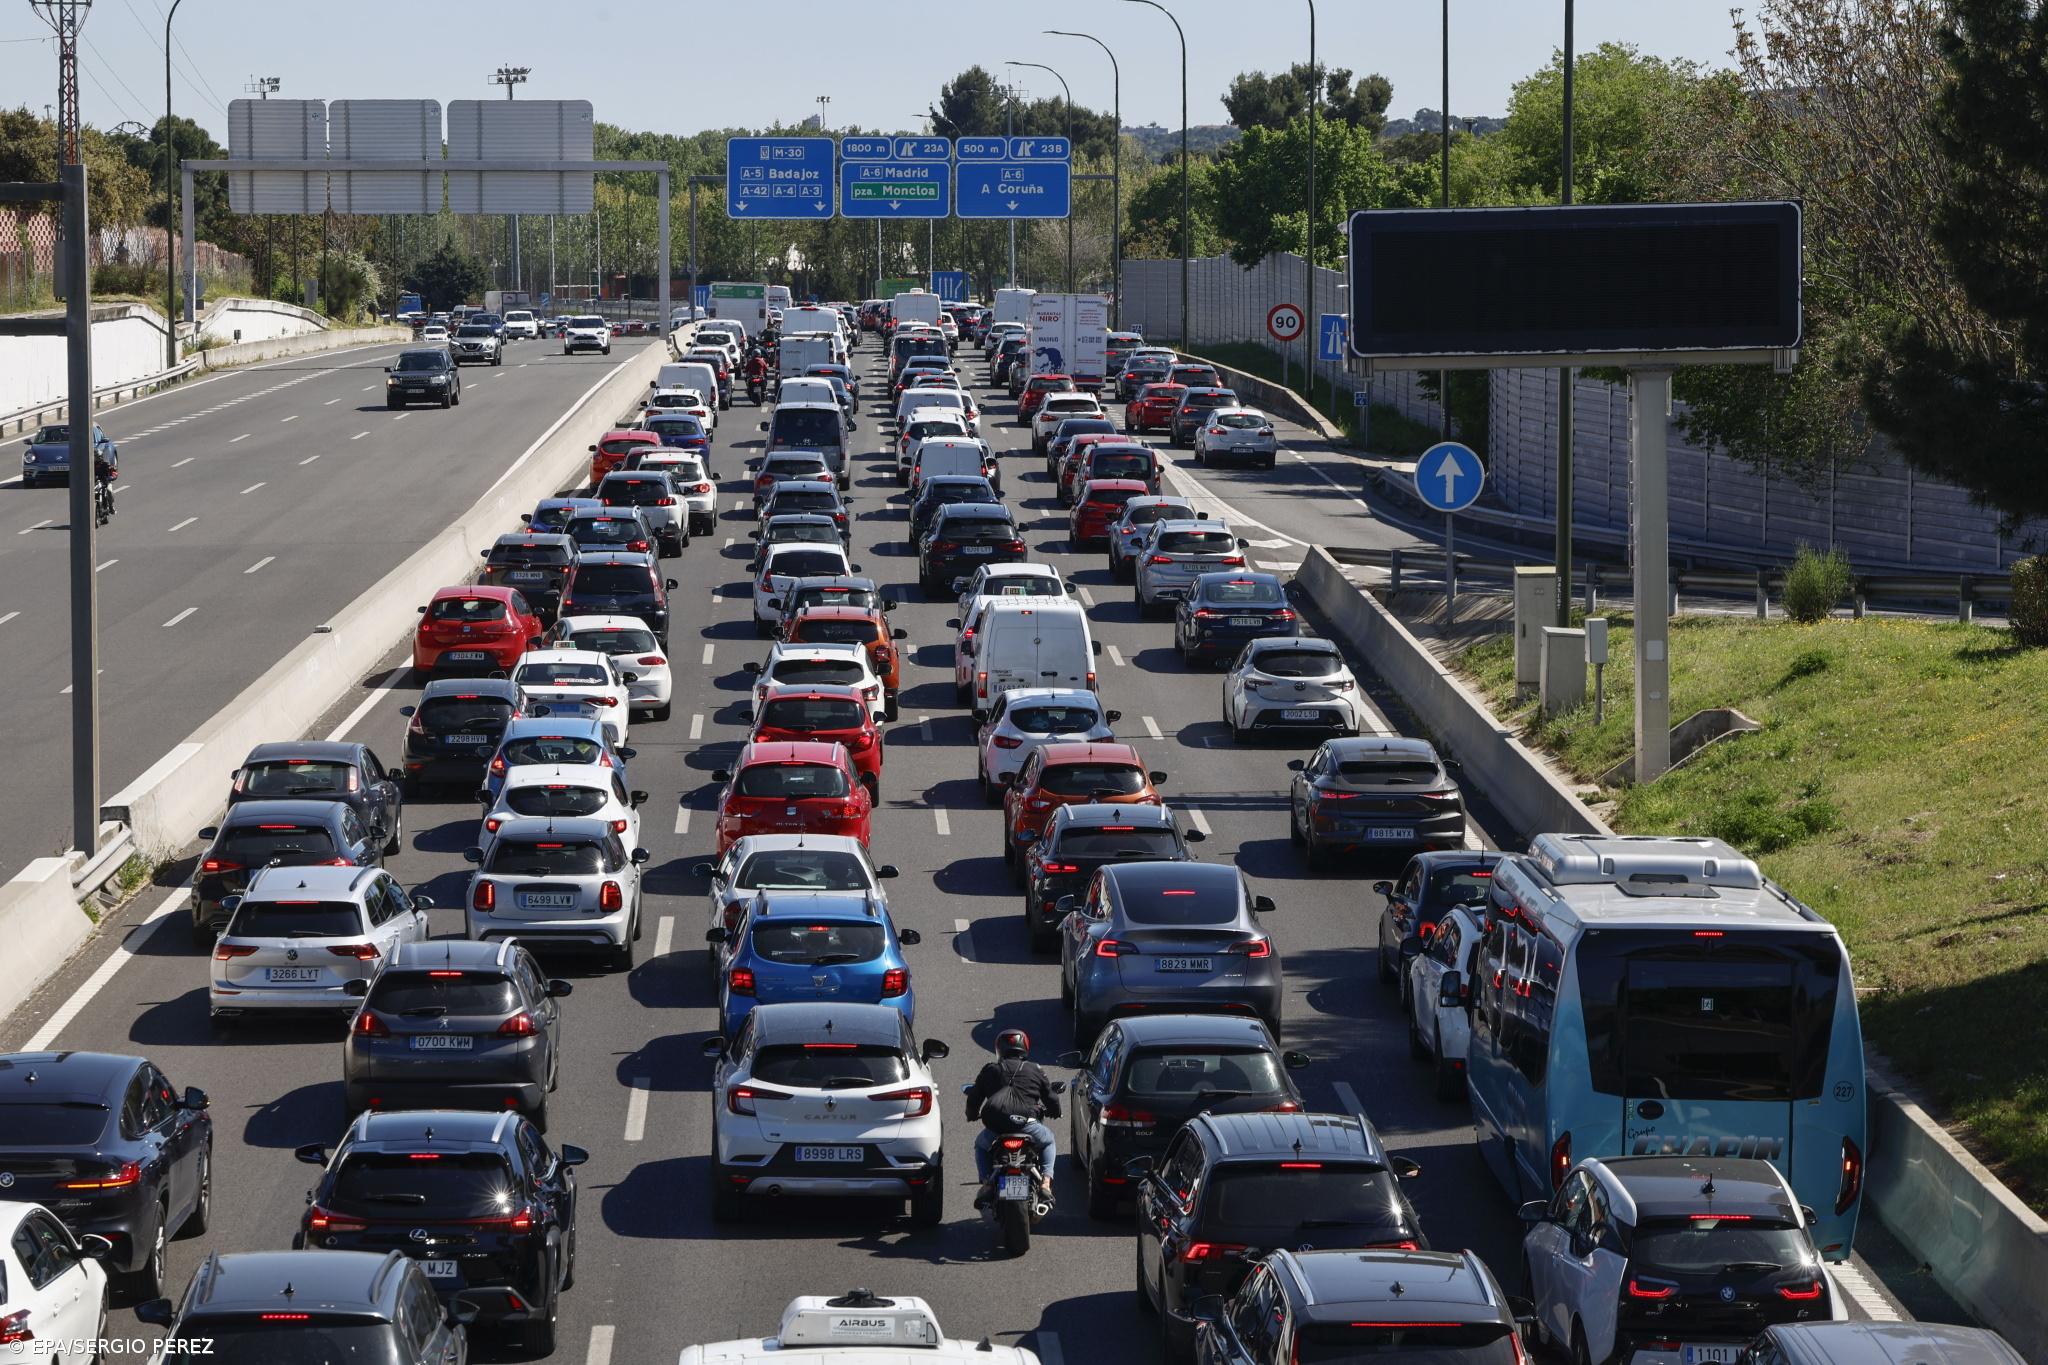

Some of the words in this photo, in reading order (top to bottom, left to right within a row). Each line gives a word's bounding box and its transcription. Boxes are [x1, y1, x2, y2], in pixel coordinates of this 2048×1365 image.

[775, 148, 802, 157] M-30
[847, 144, 872, 153] 1800
[924, 144, 944, 153] 23A
[963, 144, 984, 153] 500
[1041, 144, 1063, 153] 23B
[743, 169, 762, 178] A-5
[769, 168, 819, 181] Badajoz
[863, 168, 881, 177] A-6
[885, 167, 929, 178] Madrid
[1004, 170, 1021, 179] A-6
[742, 186, 768, 195] A-42
[775, 187, 794, 195] A-4
[802, 186, 820, 195] A-3
[854, 187, 877, 197] pza.
[882, 185, 936, 195] Moncloa
[981, 184, 990, 194] A
[998, 183, 1044, 194] Coruña
[1276, 316, 1296, 328] 90
[528, 895, 551, 904] 6499
[553, 895, 572, 905] LVW
[1161, 959, 1187, 968] 8829
[1190, 959, 1209, 968] MMR
[272, 969, 297, 979] 3266
[300, 969, 320, 979] LYT
[418, 1036, 446, 1047] 0700
[450, 1036, 470, 1048] KWM
[1836, 1086, 1852, 1097] 227
[1628, 1126, 1656, 1140] Grupo
[804, 1148, 835, 1160] 8998
[839, 1148, 862, 1160] LRS
[1008, 1177, 1028, 1187] 1896
[1006, 1186, 1023, 1196] LTZ
[427, 1262, 453, 1275] MJZ
[839, 1319, 887, 1327] AIRBUS
[1698, 1348, 1728, 1362] 1101
